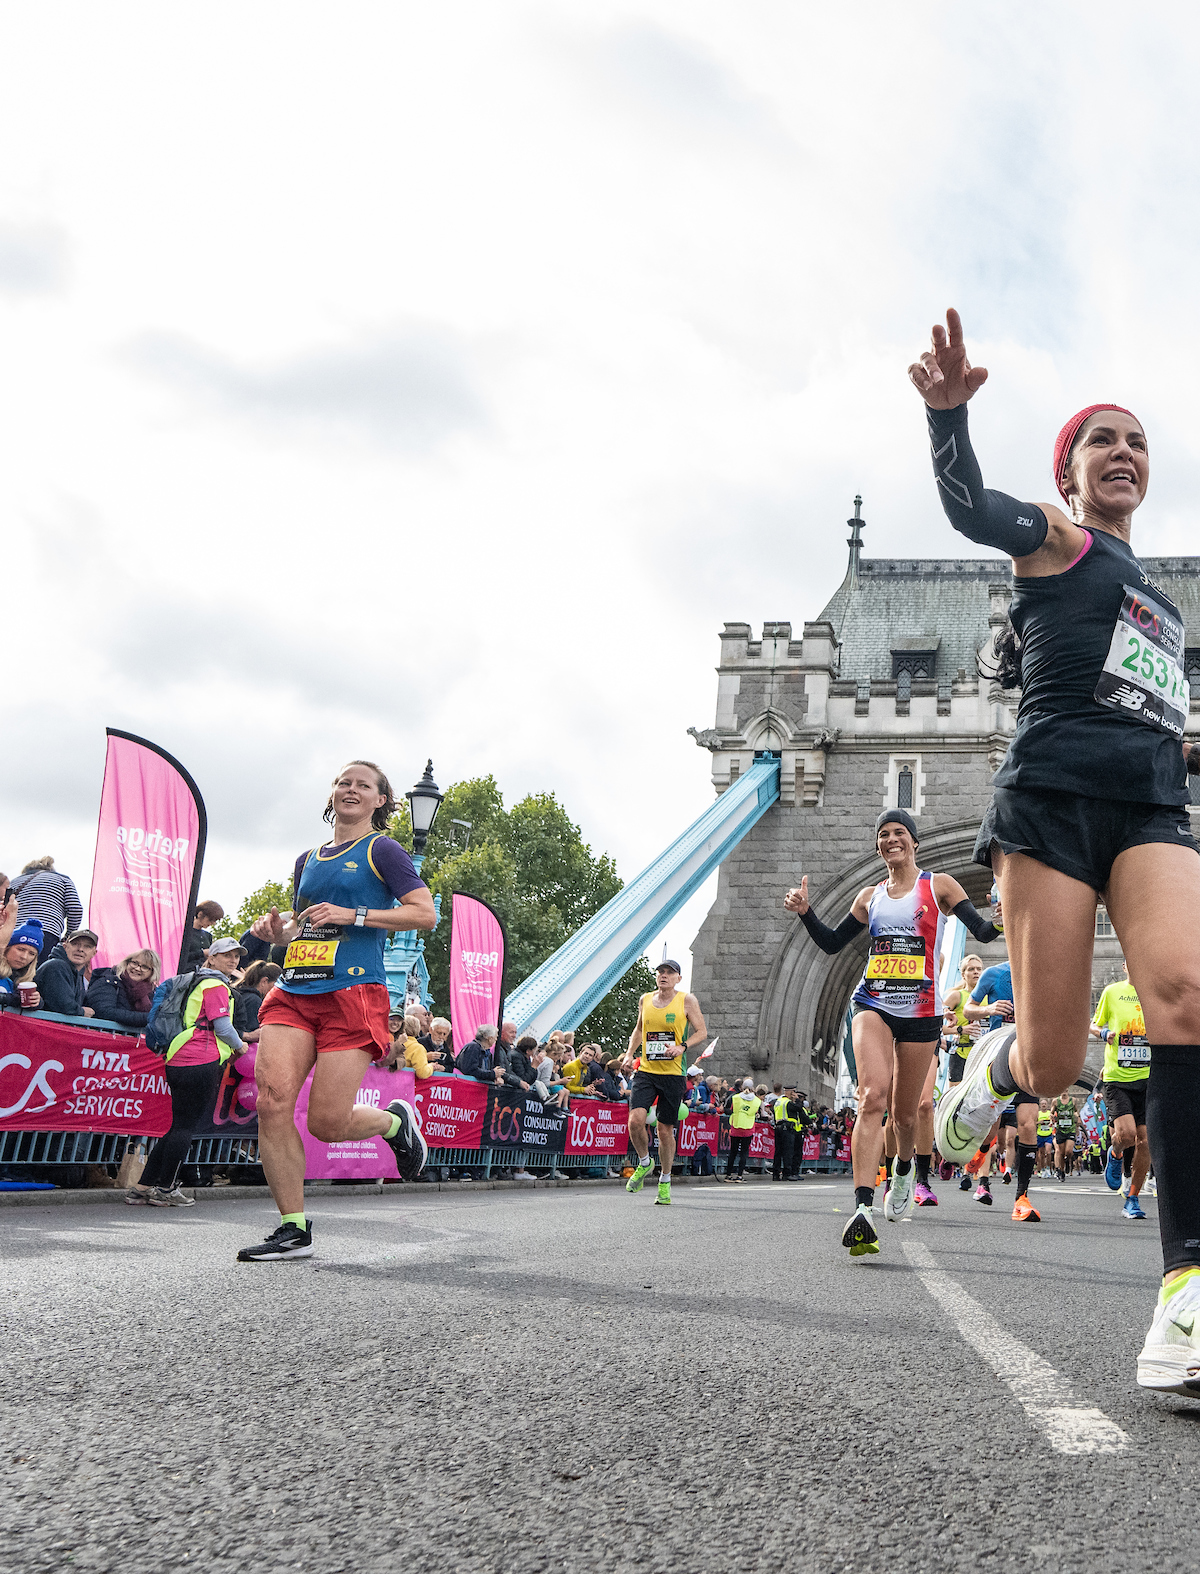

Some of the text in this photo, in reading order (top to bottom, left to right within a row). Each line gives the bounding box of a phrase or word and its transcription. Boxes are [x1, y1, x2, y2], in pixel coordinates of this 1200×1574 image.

[1128, 594, 1161, 636] tcs
[1163, 616, 1180, 635] TATA
[1160, 635, 1180, 656] SERVIC
[1143, 707, 1184, 737] new balan
[287, 944, 329, 963] 34342
[873, 958, 917, 975] 32769
[81, 1048, 131, 1072] TATA
[1122, 1048, 1147, 1058] 13118
[0, 1053, 64, 1118] cs
[430, 1086, 452, 1101] TATA
[63, 1095, 143, 1119] SERVICES
[427, 1103, 479, 1122] CONSULTANCY
[525, 1099, 544, 1114] TATA
[597, 1109, 612, 1121] TATA
[490, 1097, 521, 1141] tcs
[523, 1114, 564, 1132] CONSULTANCY
[571, 1108, 595, 1147] tcs
[425, 1121, 456, 1138] SERVICES
[522, 1132, 548, 1145] SERVICES
[596, 1123, 627, 1135] CONSULTANCY
[681, 1119, 697, 1150] tcs
[595, 1137, 615, 1147] SERVICES
[327, 1151, 342, 1160] gainst
